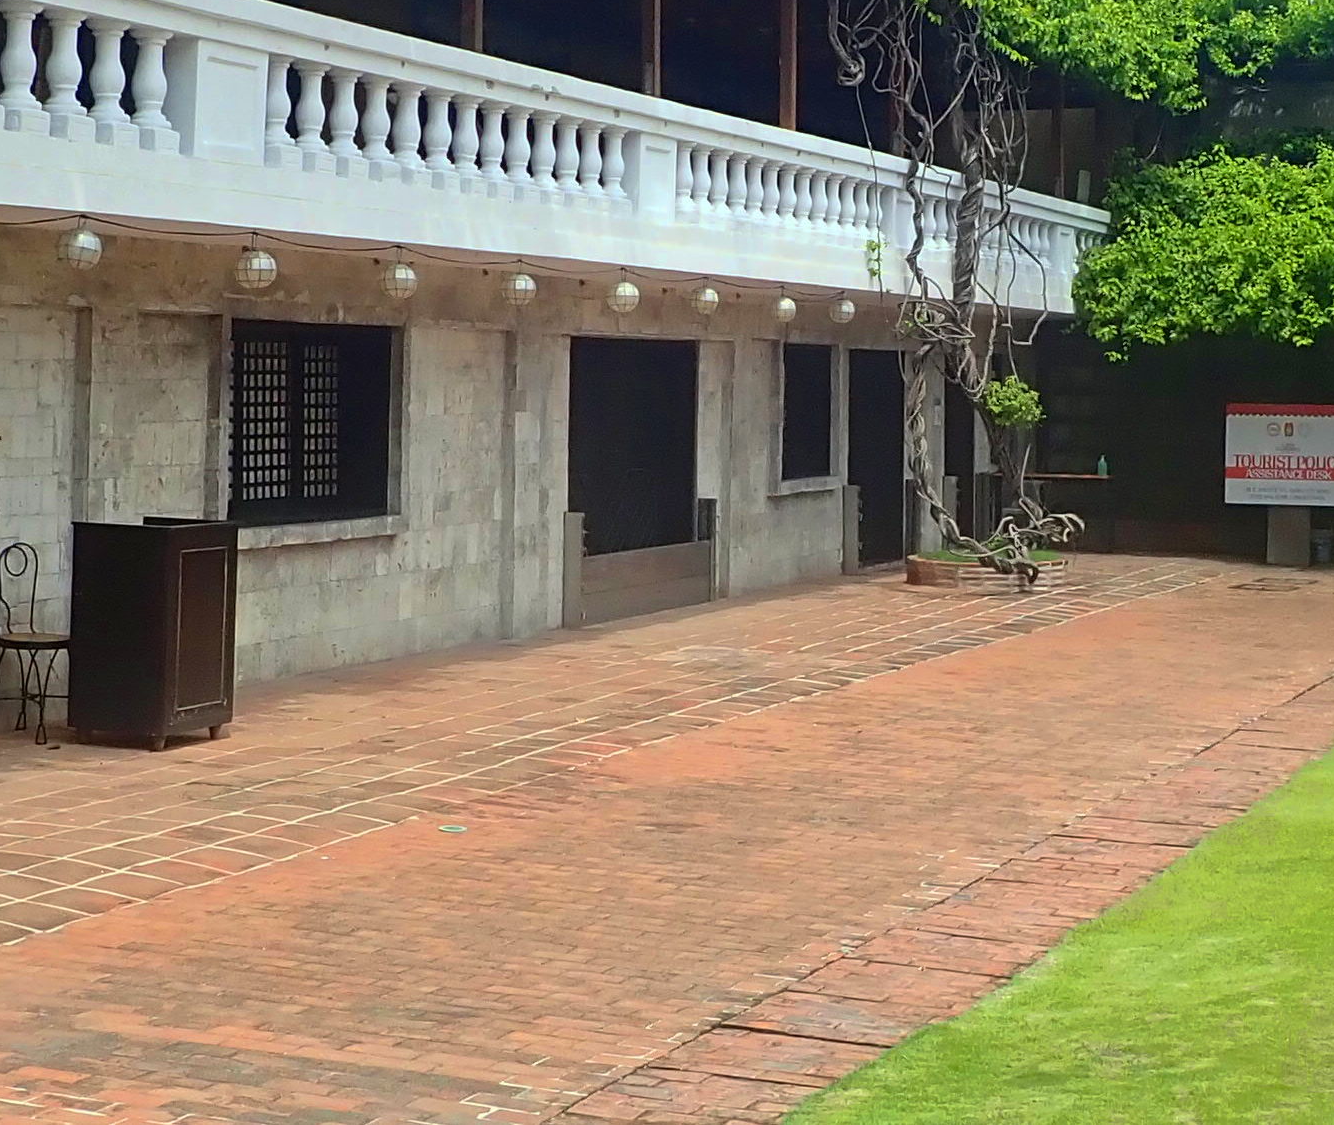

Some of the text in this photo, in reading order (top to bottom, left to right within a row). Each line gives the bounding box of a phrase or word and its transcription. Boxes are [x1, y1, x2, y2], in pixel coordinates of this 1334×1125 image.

[1233, 454, 1293, 469] TOURIST
[1245, 468, 1332, 480] ASSISTANCE DESK
